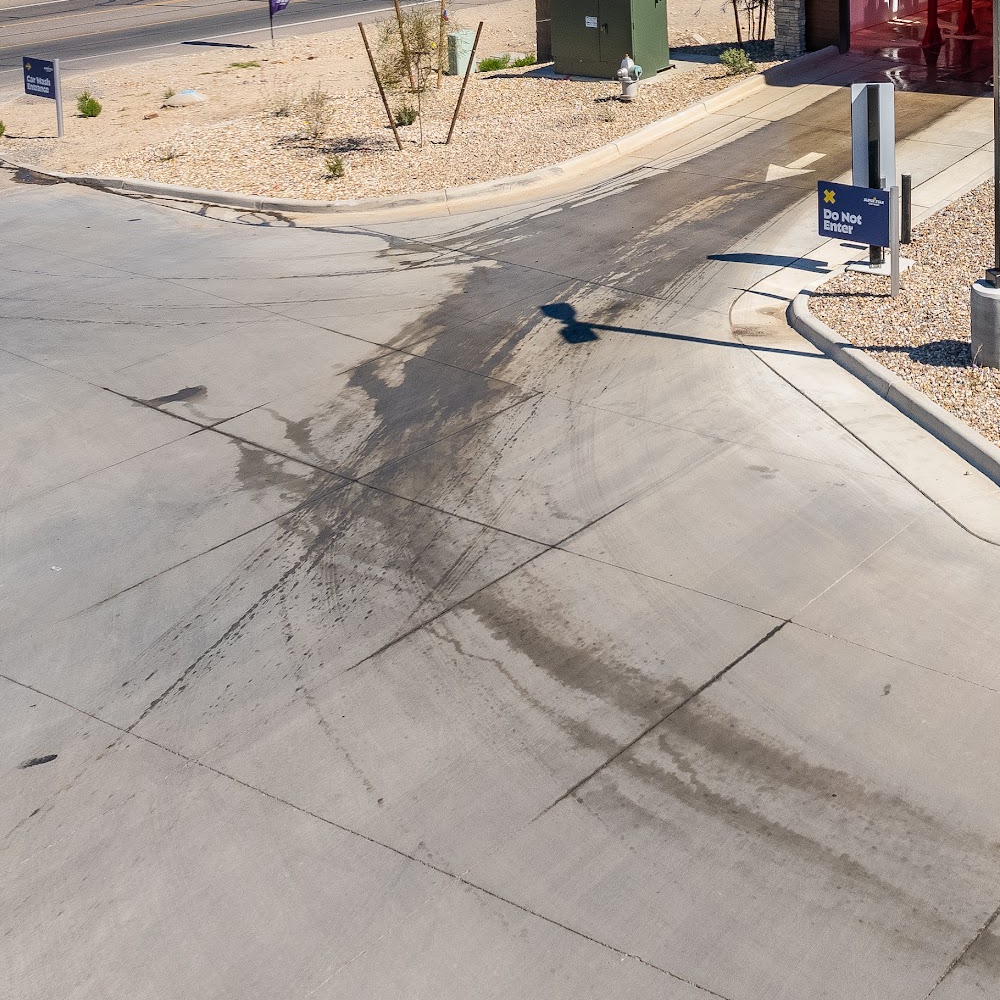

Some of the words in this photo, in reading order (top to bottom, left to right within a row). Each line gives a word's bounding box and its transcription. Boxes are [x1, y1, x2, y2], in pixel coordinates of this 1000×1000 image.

[823, 209, 839, 220] Do
[842, 211, 862, 225] Not
[824, 220, 853, 234] Enter
